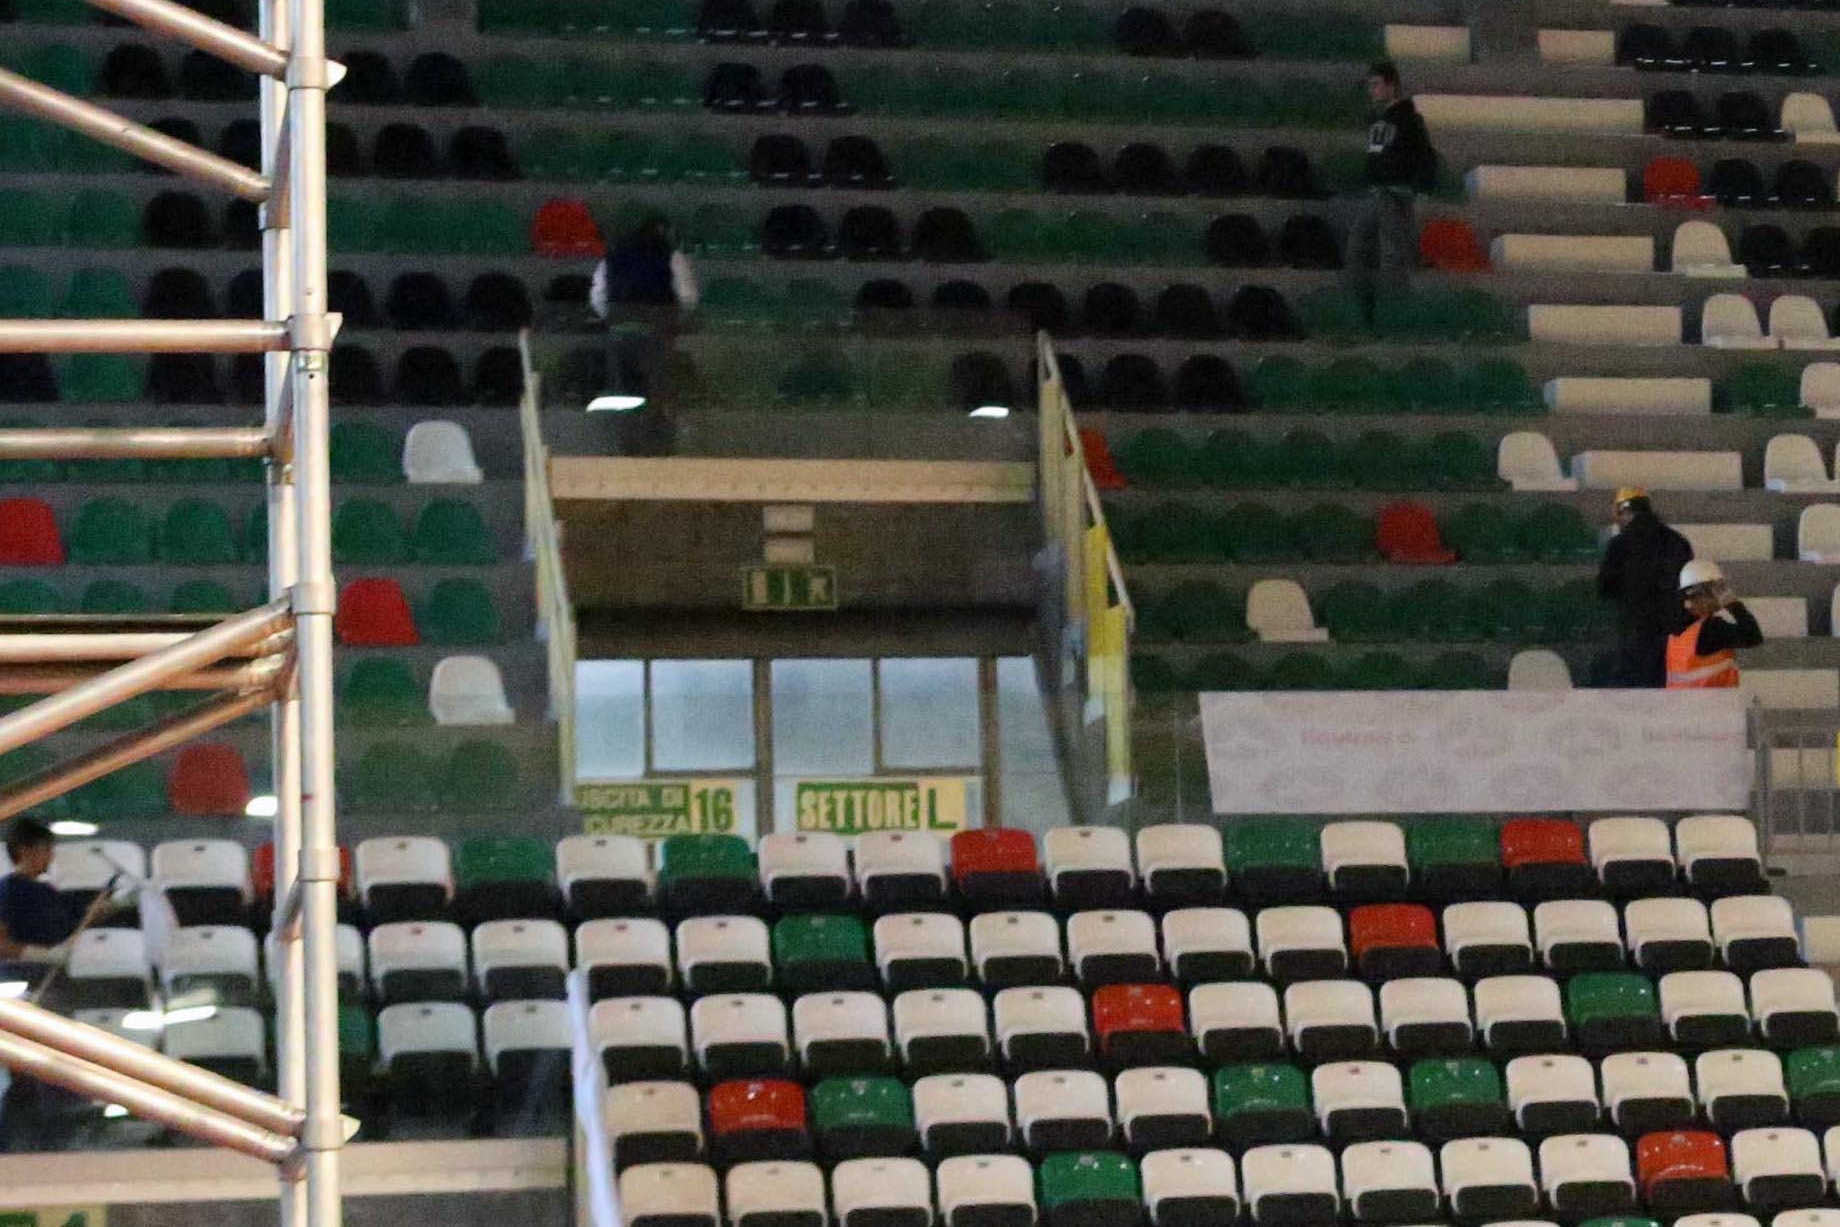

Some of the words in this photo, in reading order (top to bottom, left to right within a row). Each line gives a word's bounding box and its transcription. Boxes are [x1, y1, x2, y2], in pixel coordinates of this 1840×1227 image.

[661, 786, 684, 808] DI
[695, 787, 734, 833] 16
[800, 789, 919, 829] SETTORE
[928, 788, 957, 829] L
